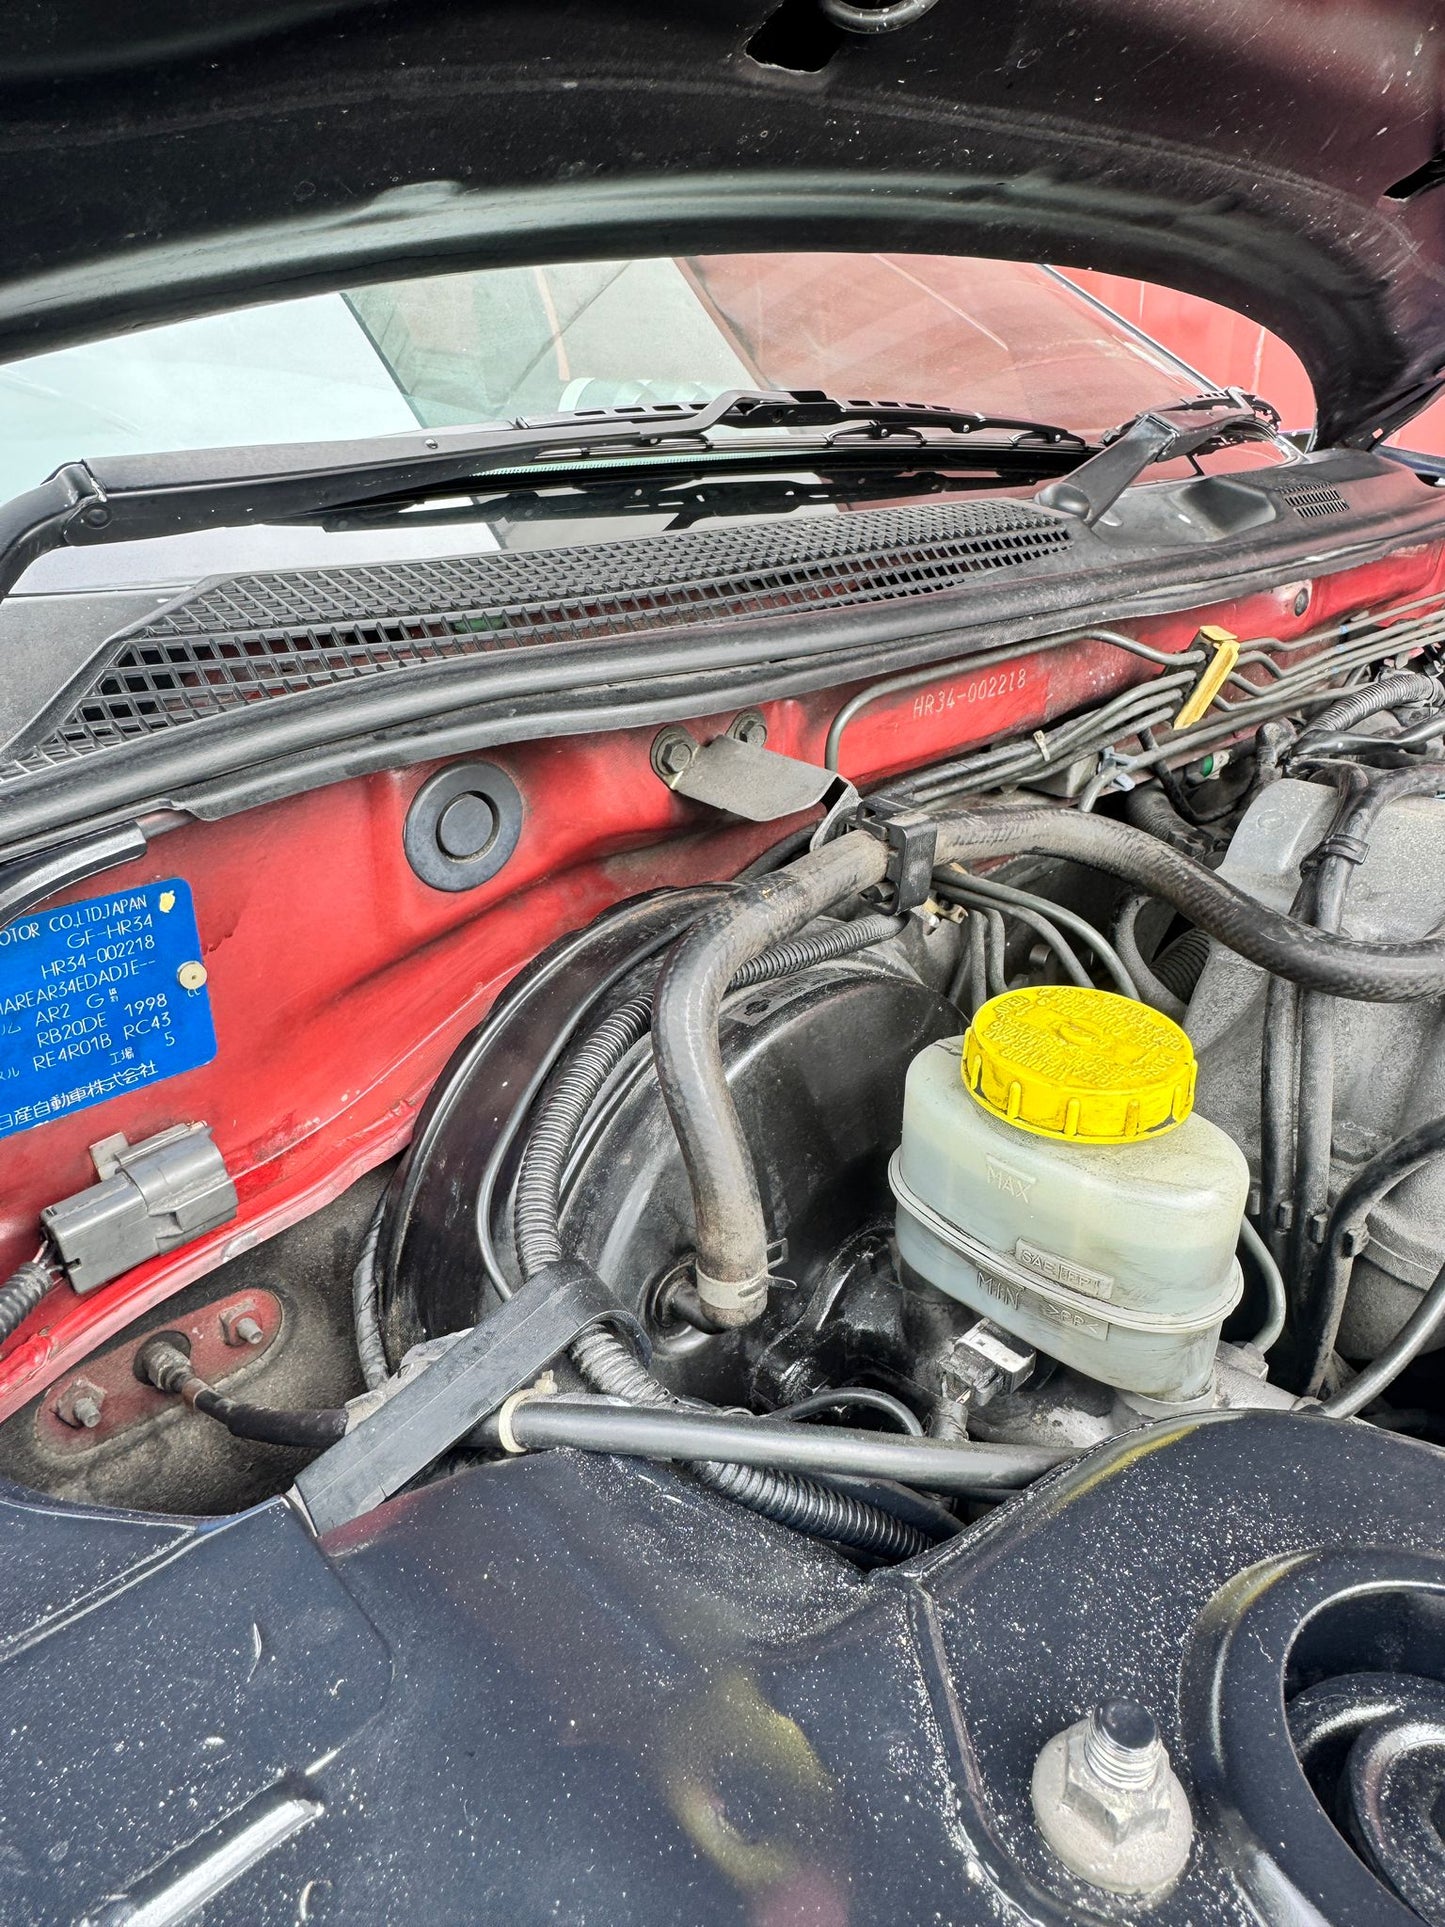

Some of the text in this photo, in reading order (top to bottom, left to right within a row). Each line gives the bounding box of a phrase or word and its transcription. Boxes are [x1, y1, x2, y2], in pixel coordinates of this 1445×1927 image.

[912, 668, 1026, 719] HR34-002218
[67, 913, 153, 949] GF-HR34
[41, 934, 156, 980] HR34-002218
[36, 1002, 71, 1028] AR2
[86, 993, 105, 1009] G
[36, 1011, 108, 1048] RB20DE
[124, 993, 168, 1017] 1998
[32, 1011, 171, 1072] RE4R01B RC43
[164, 1031, 176, 1047] 5
[0, 1060, 159, 1130] 日産自動車株式会社
[986, 1164, 1031, 1204] MAX
[976, 1271, 1020, 1311] MIN
